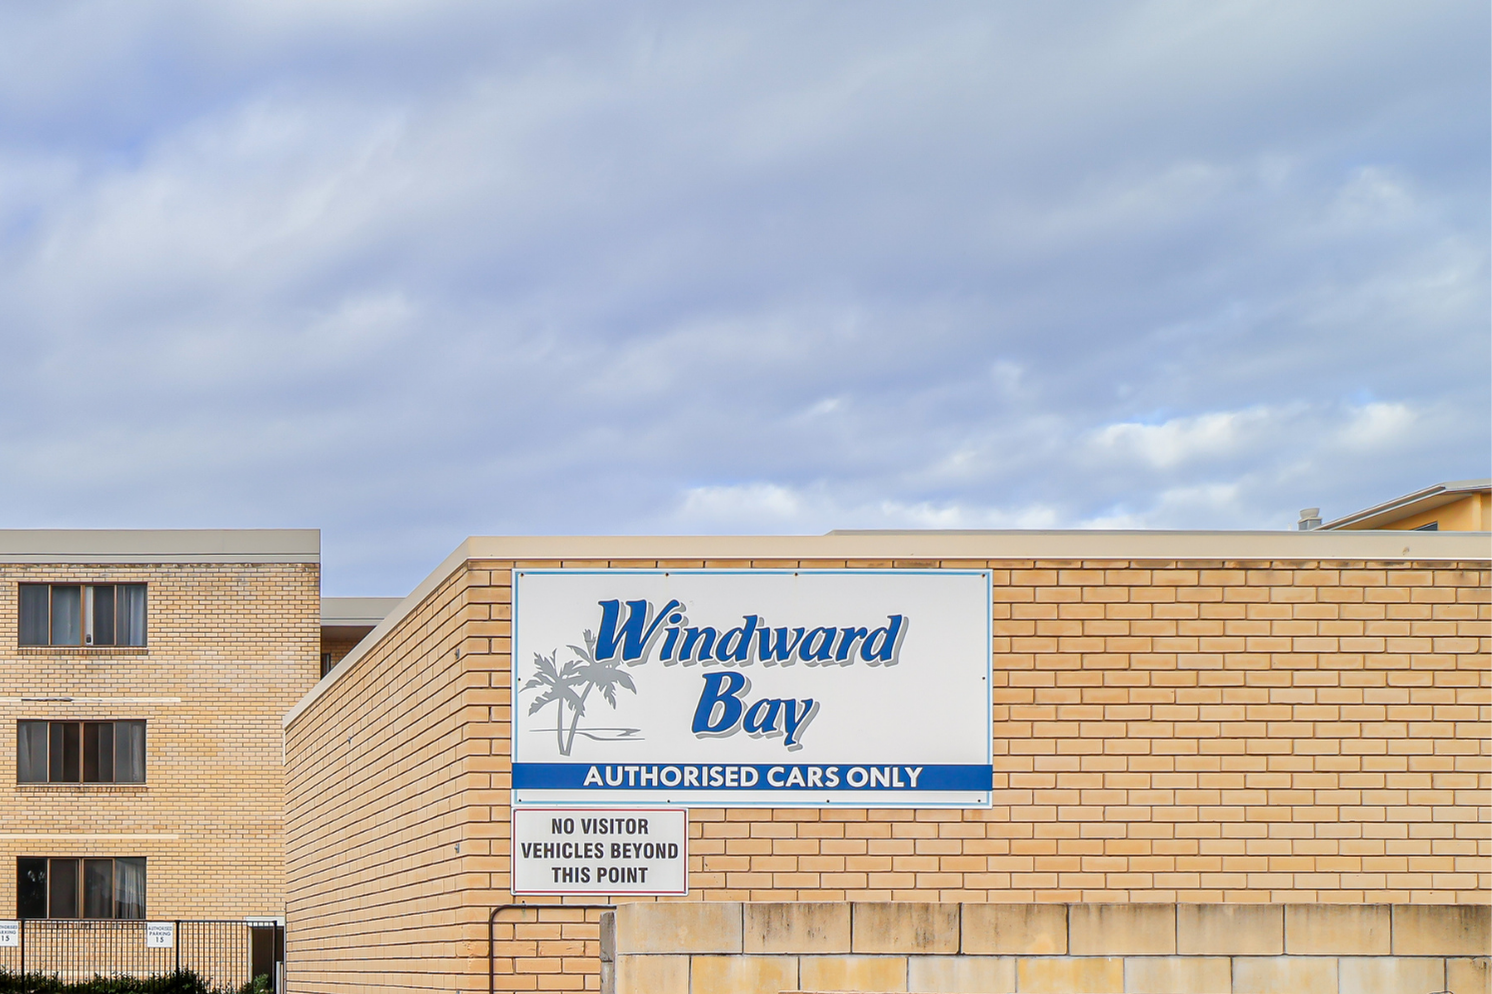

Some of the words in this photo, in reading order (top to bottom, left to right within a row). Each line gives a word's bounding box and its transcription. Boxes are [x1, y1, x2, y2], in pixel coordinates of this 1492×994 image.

[593, 599, 908, 666] Windward
[691, 671, 819, 752] Bay
[583, 766, 759, 787] AUTHORISED
[766, 766, 839, 787] CARS
[846, 767, 923, 788] ONLY
[551, 818, 575, 835] NO
[581, 818, 649, 835] VISITOR
[521, 842, 604, 860] VEHICLES
[610, 842, 679, 860] BEYOND
[552, 867, 590, 884] THIS
[597, 867, 648, 884] POINT
